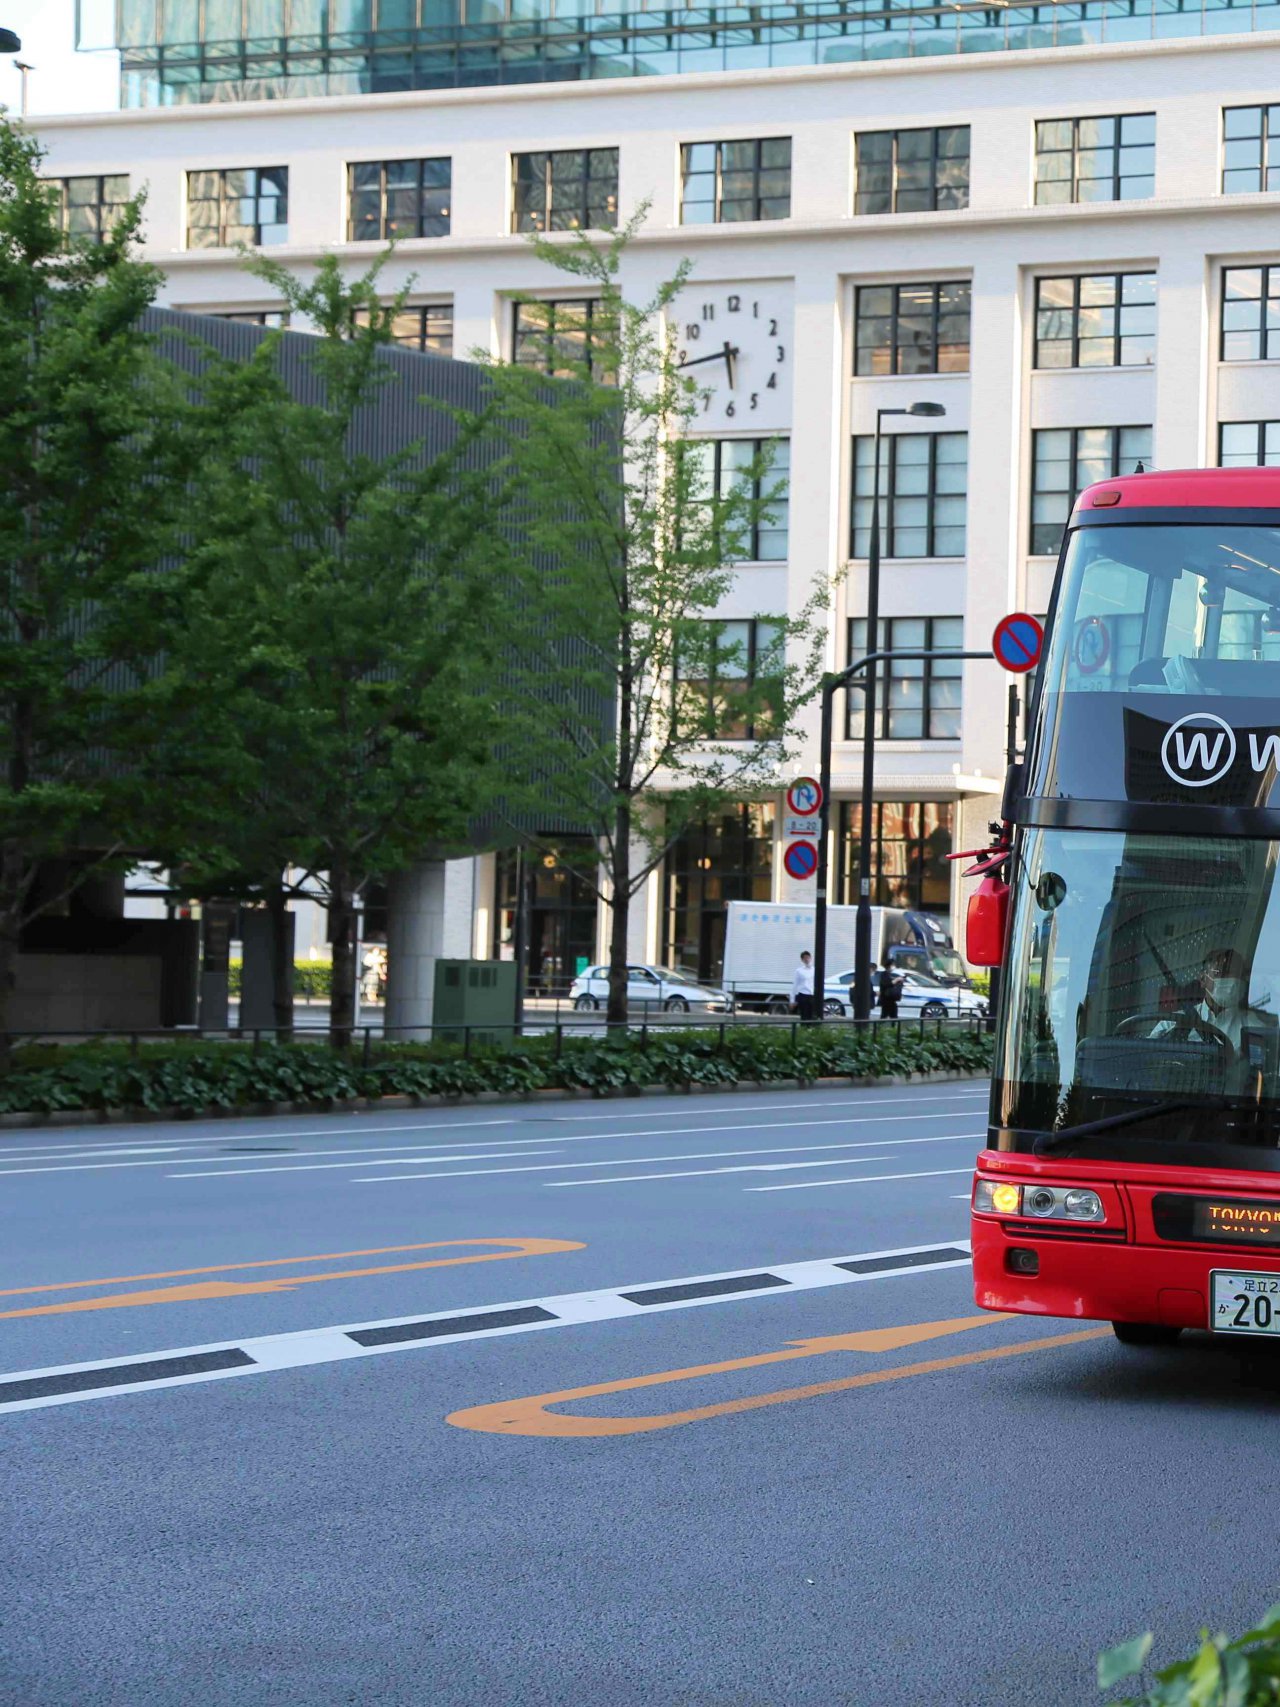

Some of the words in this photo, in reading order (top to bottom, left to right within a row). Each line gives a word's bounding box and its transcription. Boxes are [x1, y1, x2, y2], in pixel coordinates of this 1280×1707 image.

[702, 304, 714, 320] 11
[728, 295, 741, 312] 12
[753, 301, 759, 318] 1
[686, 323, 699, 340] 10
[769, 319, 778, 337] 2
[679, 350, 687, 366] 9
[776, 345, 785, 363] 3
[766, 372, 777, 389] 4
[702, 391, 711, 412] 7
[725, 401, 736, 417] 6
[750, 393, 758, 410] 5
[1218, 1304, 1229, 1314] か
